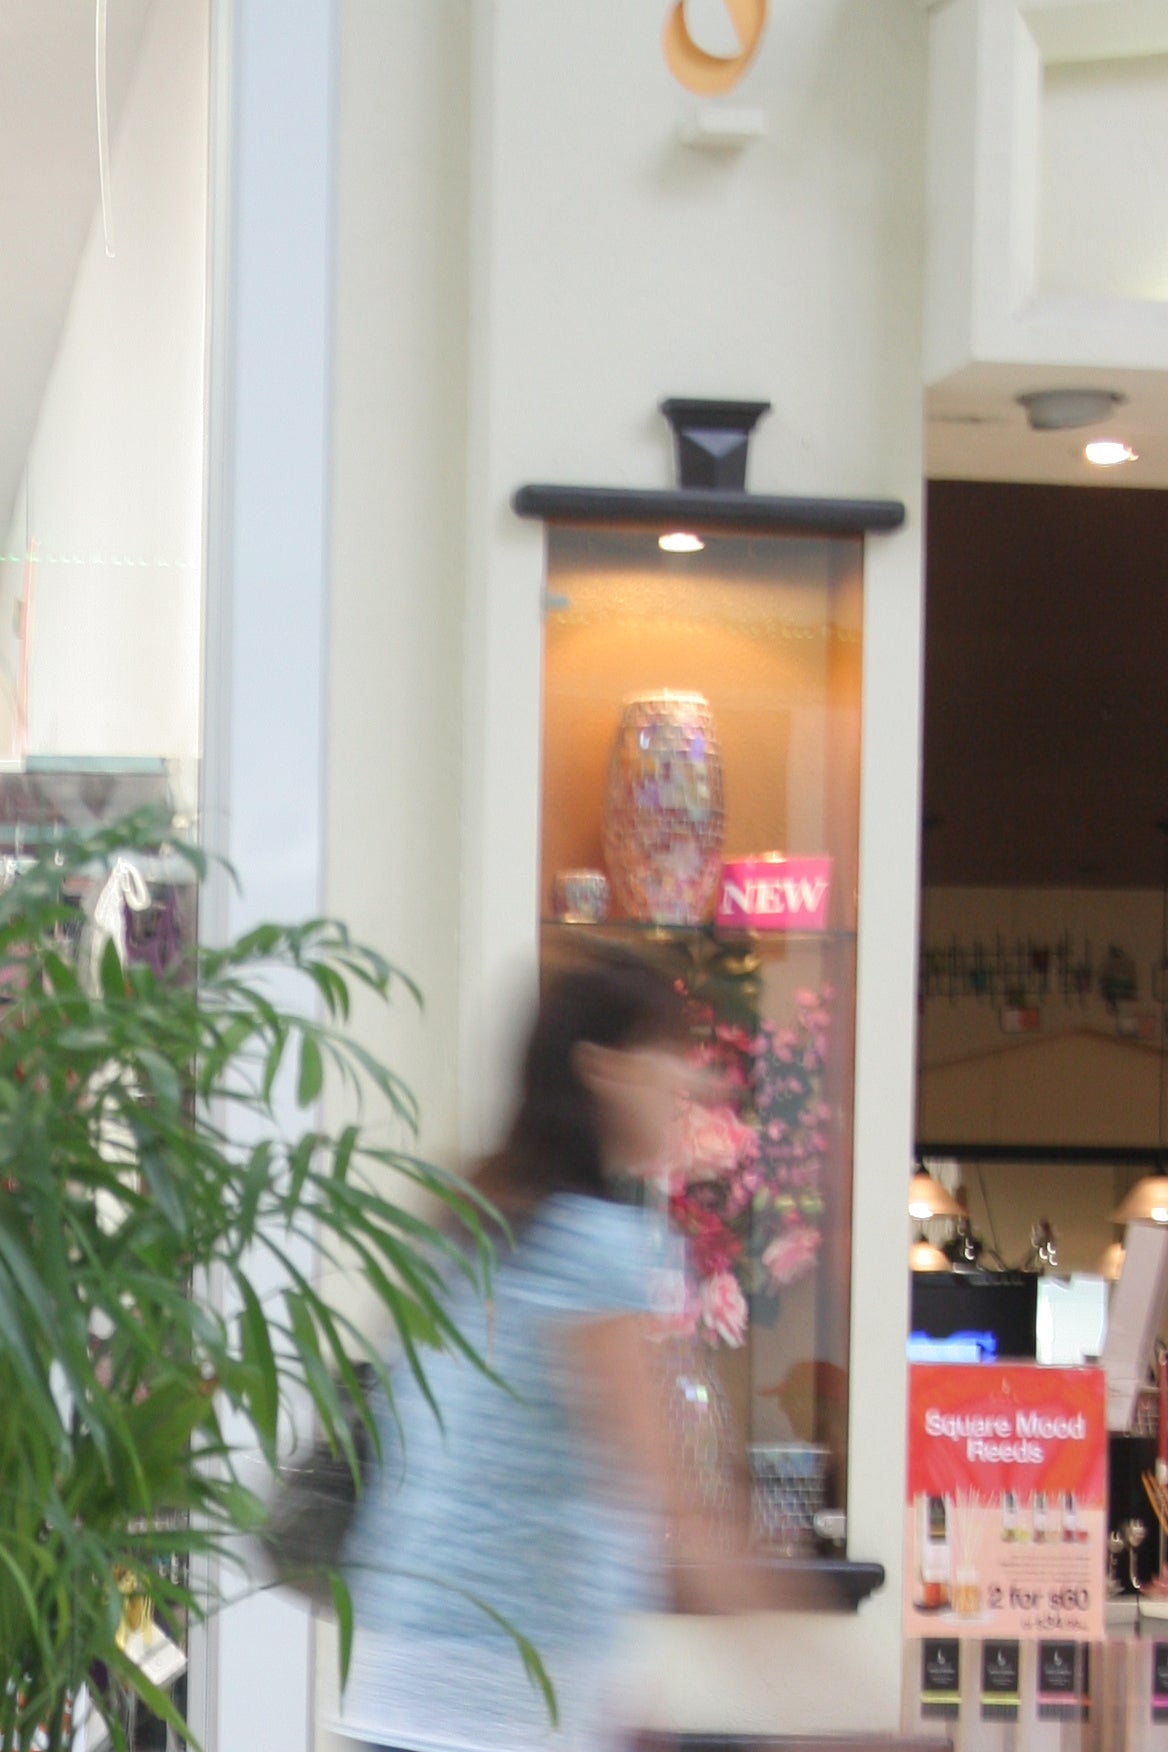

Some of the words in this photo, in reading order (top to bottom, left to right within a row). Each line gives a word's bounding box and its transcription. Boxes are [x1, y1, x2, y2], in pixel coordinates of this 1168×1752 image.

[721, 879, 828, 915] NEW
[925, 1408, 1011, 1441] Square
[1016, 1410, 1087, 1439] Mood
[967, 1438, 1044, 1464] Reeds
